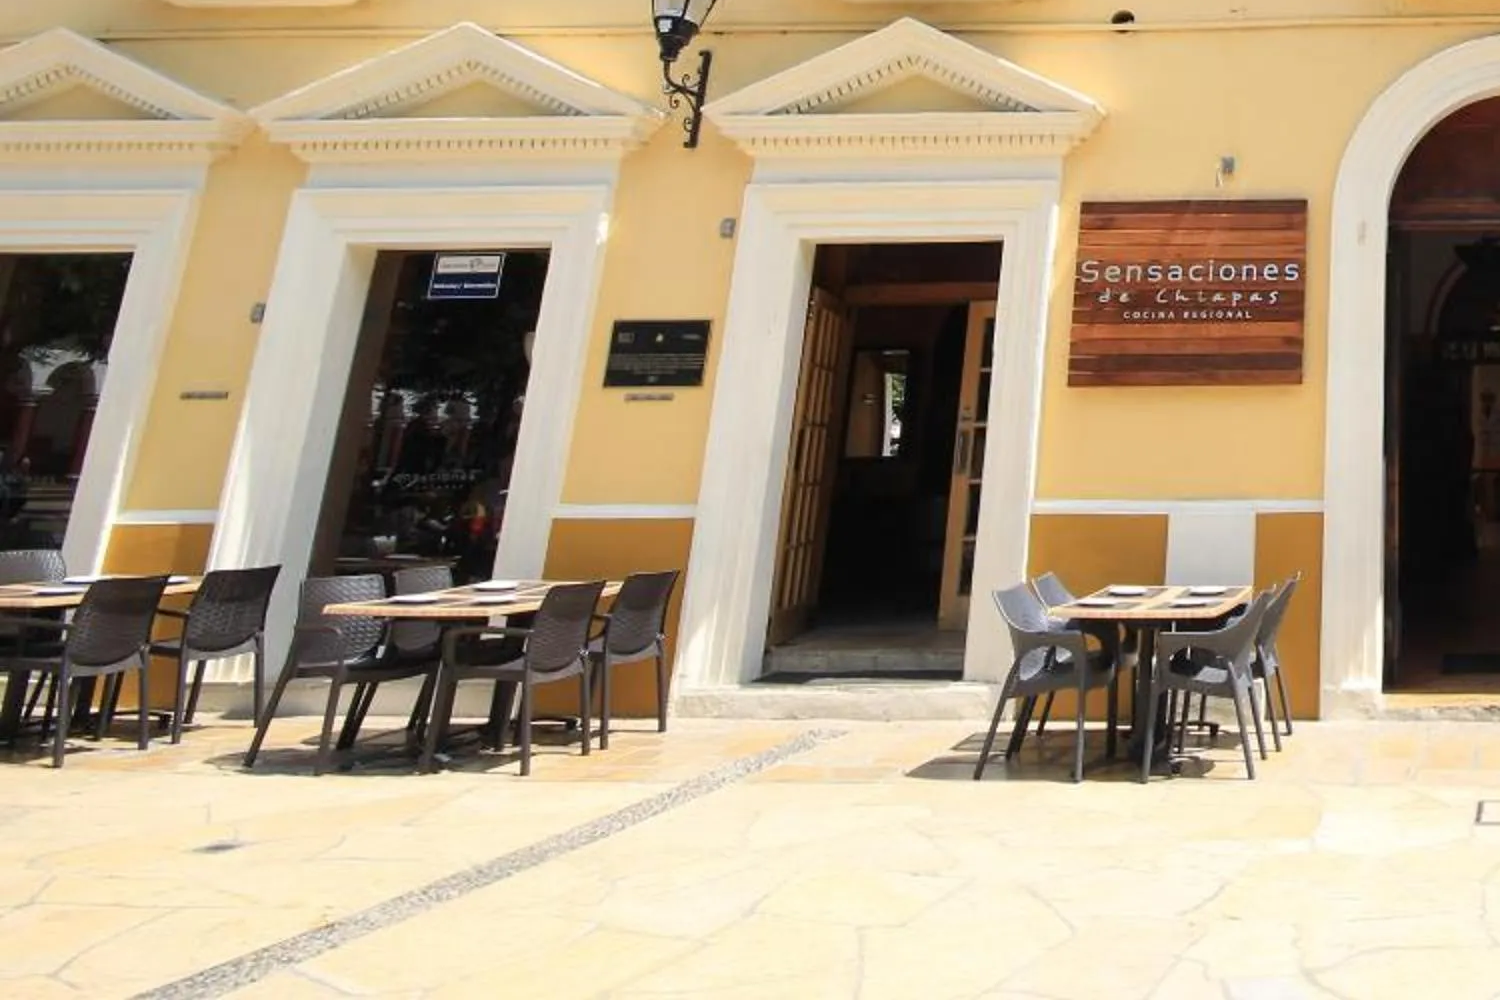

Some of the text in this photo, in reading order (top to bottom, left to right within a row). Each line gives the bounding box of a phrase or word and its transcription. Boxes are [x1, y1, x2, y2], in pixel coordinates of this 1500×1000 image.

[1080, 259, 1300, 283] Sensaciones
[1099, 288, 1280, 306] de Chiapas
[1123, 310, 1252, 319] COCINA REGIONAL
